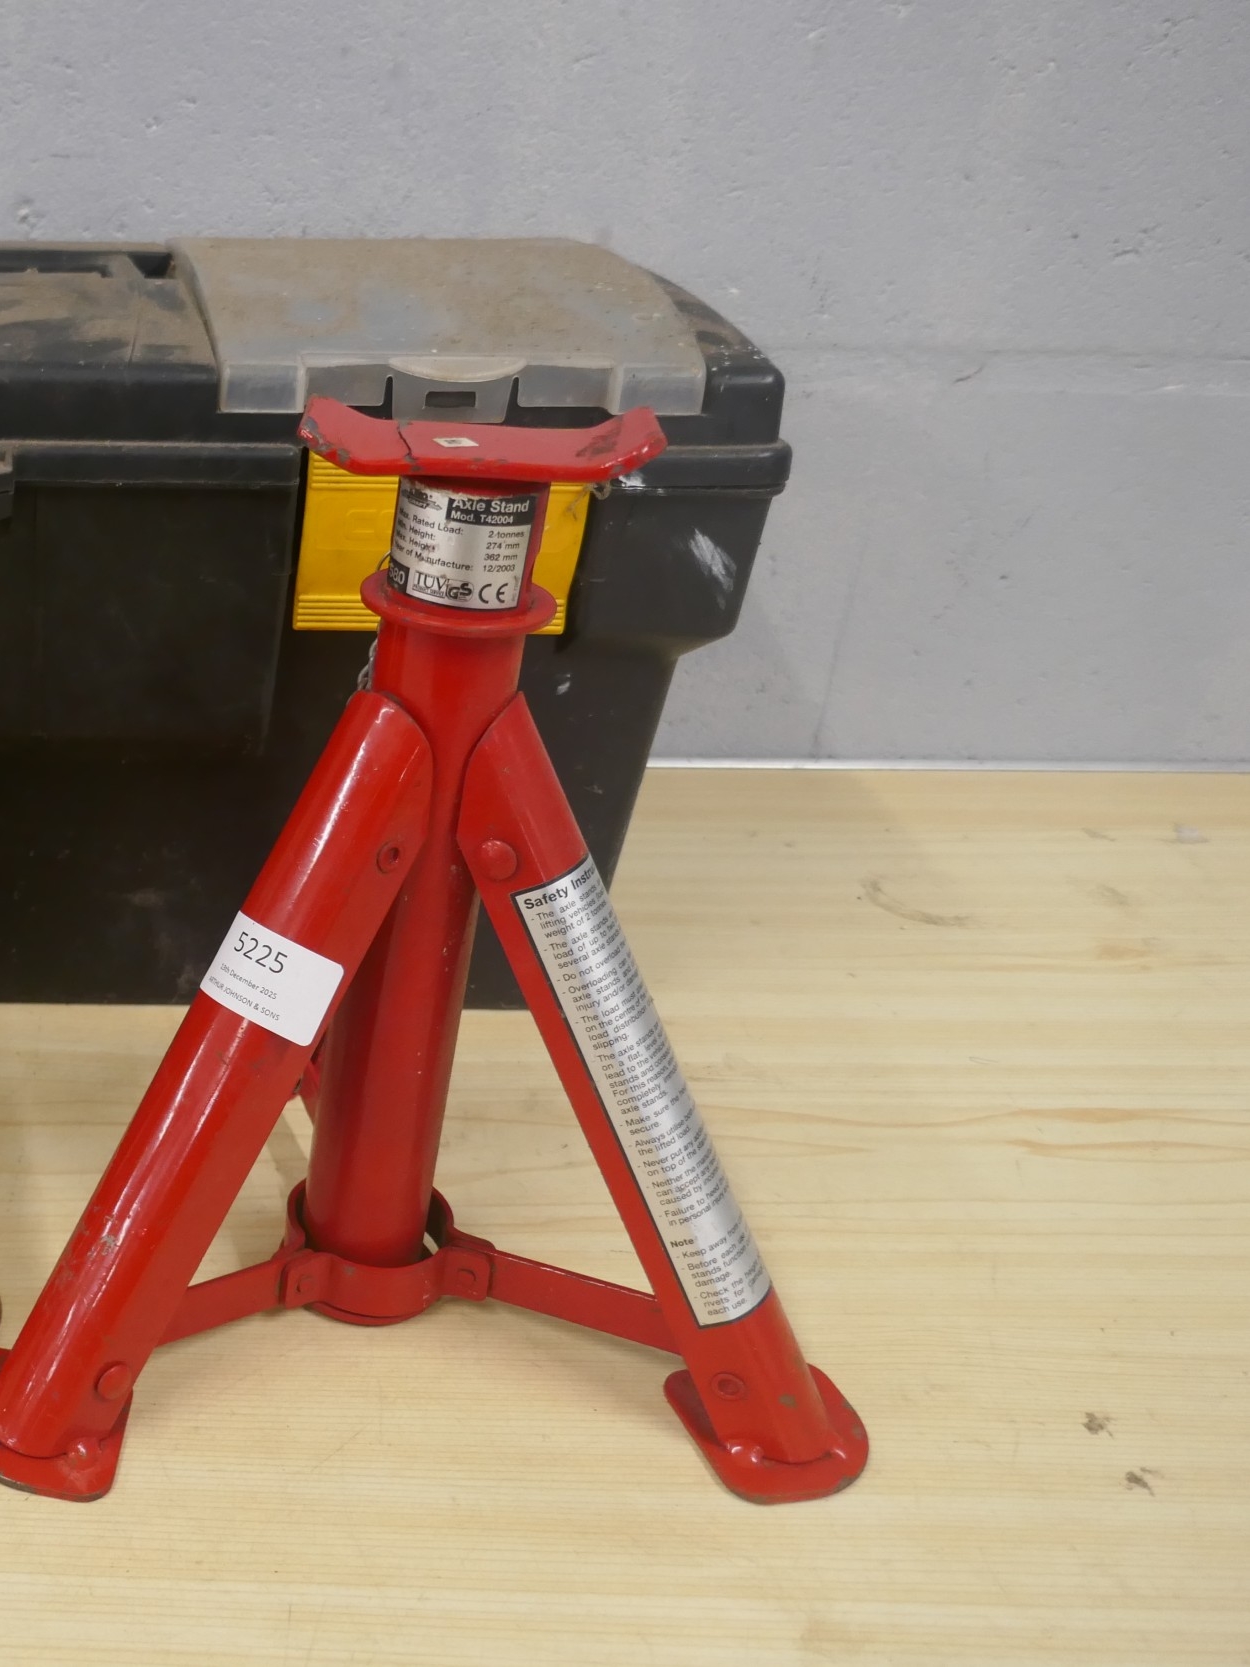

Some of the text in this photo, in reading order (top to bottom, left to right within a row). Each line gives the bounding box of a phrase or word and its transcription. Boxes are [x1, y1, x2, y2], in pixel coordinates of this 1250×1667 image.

[452, 500, 529, 512] Axle Stand
[413, 515, 435, 528] Rated
[438, 523, 463, 535] Load:
[451, 511, 513, 523] Mod. T42004
[409, 525, 435, 540] Height:
[478, 583, 508, 604] CE
[524, 886, 569, 909] Safety
[537, 911, 554, 920] The
[559, 900, 576, 913] axle
[580, 886, 596, 902] stands
[540, 917, 566, 930] lifting
[545, 922, 575, 938] weight
[577, 917, 583, 926] of
[550, 942, 567, 951] The
[571, 932, 588, 944] axle
[553, 949, 574, 960] load
[578, 943, 585, 951] of
[589, 936, 598, 946] up
[234, 932, 288, 973] 5225
[558, 943, 605, 969] several axle
[569, 968, 617, 993] Overloading
[579, 966, 593, 977] not
[230, 970, 259, 990] December
[260, 987, 277, 999] 2025
[573, 993, 591, 1003] axle
[596, 977, 620, 994] stands
[224, 987, 253, 1006] JOHNSON
[260, 1007, 280, 1021] SONS
[576, 984, 626, 1012] injury and/or
[581, 1015, 599, 1023] The
[601, 1004, 620, 1017] load
[599, 1020, 612, 1029] the
[615, 1005, 635, 1021] centre
[589, 1030, 609, 1041] load
[593, 1033, 629, 1050] slipping.
[598, 1053, 615, 1062] The
[618, 1044, 634, 1057] axle
[605, 1070, 625, 1079] lead
[637, 1058, 649, 1068] the
[610, 1075, 639, 1089] stands
[641, 1066, 654, 1077] and
[613, 1082, 646, 1097] For this
[617, 1083, 661, 1106] completely
[621, 1105, 639, 1115] axle
[626, 1115, 650, 1127] Make
[654, 1105, 669, 1117] sure
[630, 1121, 661, 1135] secure.
[635, 1132, 665, 1147] Always
[638, 1137, 676, 1156] the lifted
[643, 1156, 668, 1168] Never
[670, 1148, 682, 1160] put
[661, 1164, 676, 1174] top
[678, 1157, 684, 1165] of
[652, 1174, 683, 1189] Neither
[685, 1167, 695, 1176] the
[656, 1189, 672, 1197] can
[675, 1174, 700, 1193] accept
[660, 1191, 692, 1206] caused
[665, 1204, 695, 1217] Failure
[679, 1203, 711, 1225] personal
[670, 1239, 694, 1248] Note
[682, 1237, 727, 1258] Keep away
[688, 1243, 736, 1271] Before each
[692, 1266, 721, 1278] stands
[695, 1271, 732, 1288] damage.
[700, 1279, 743, 1299] Check the
[704, 1288, 744, 1308] rivets for
[708, 1306, 730, 1315] each
